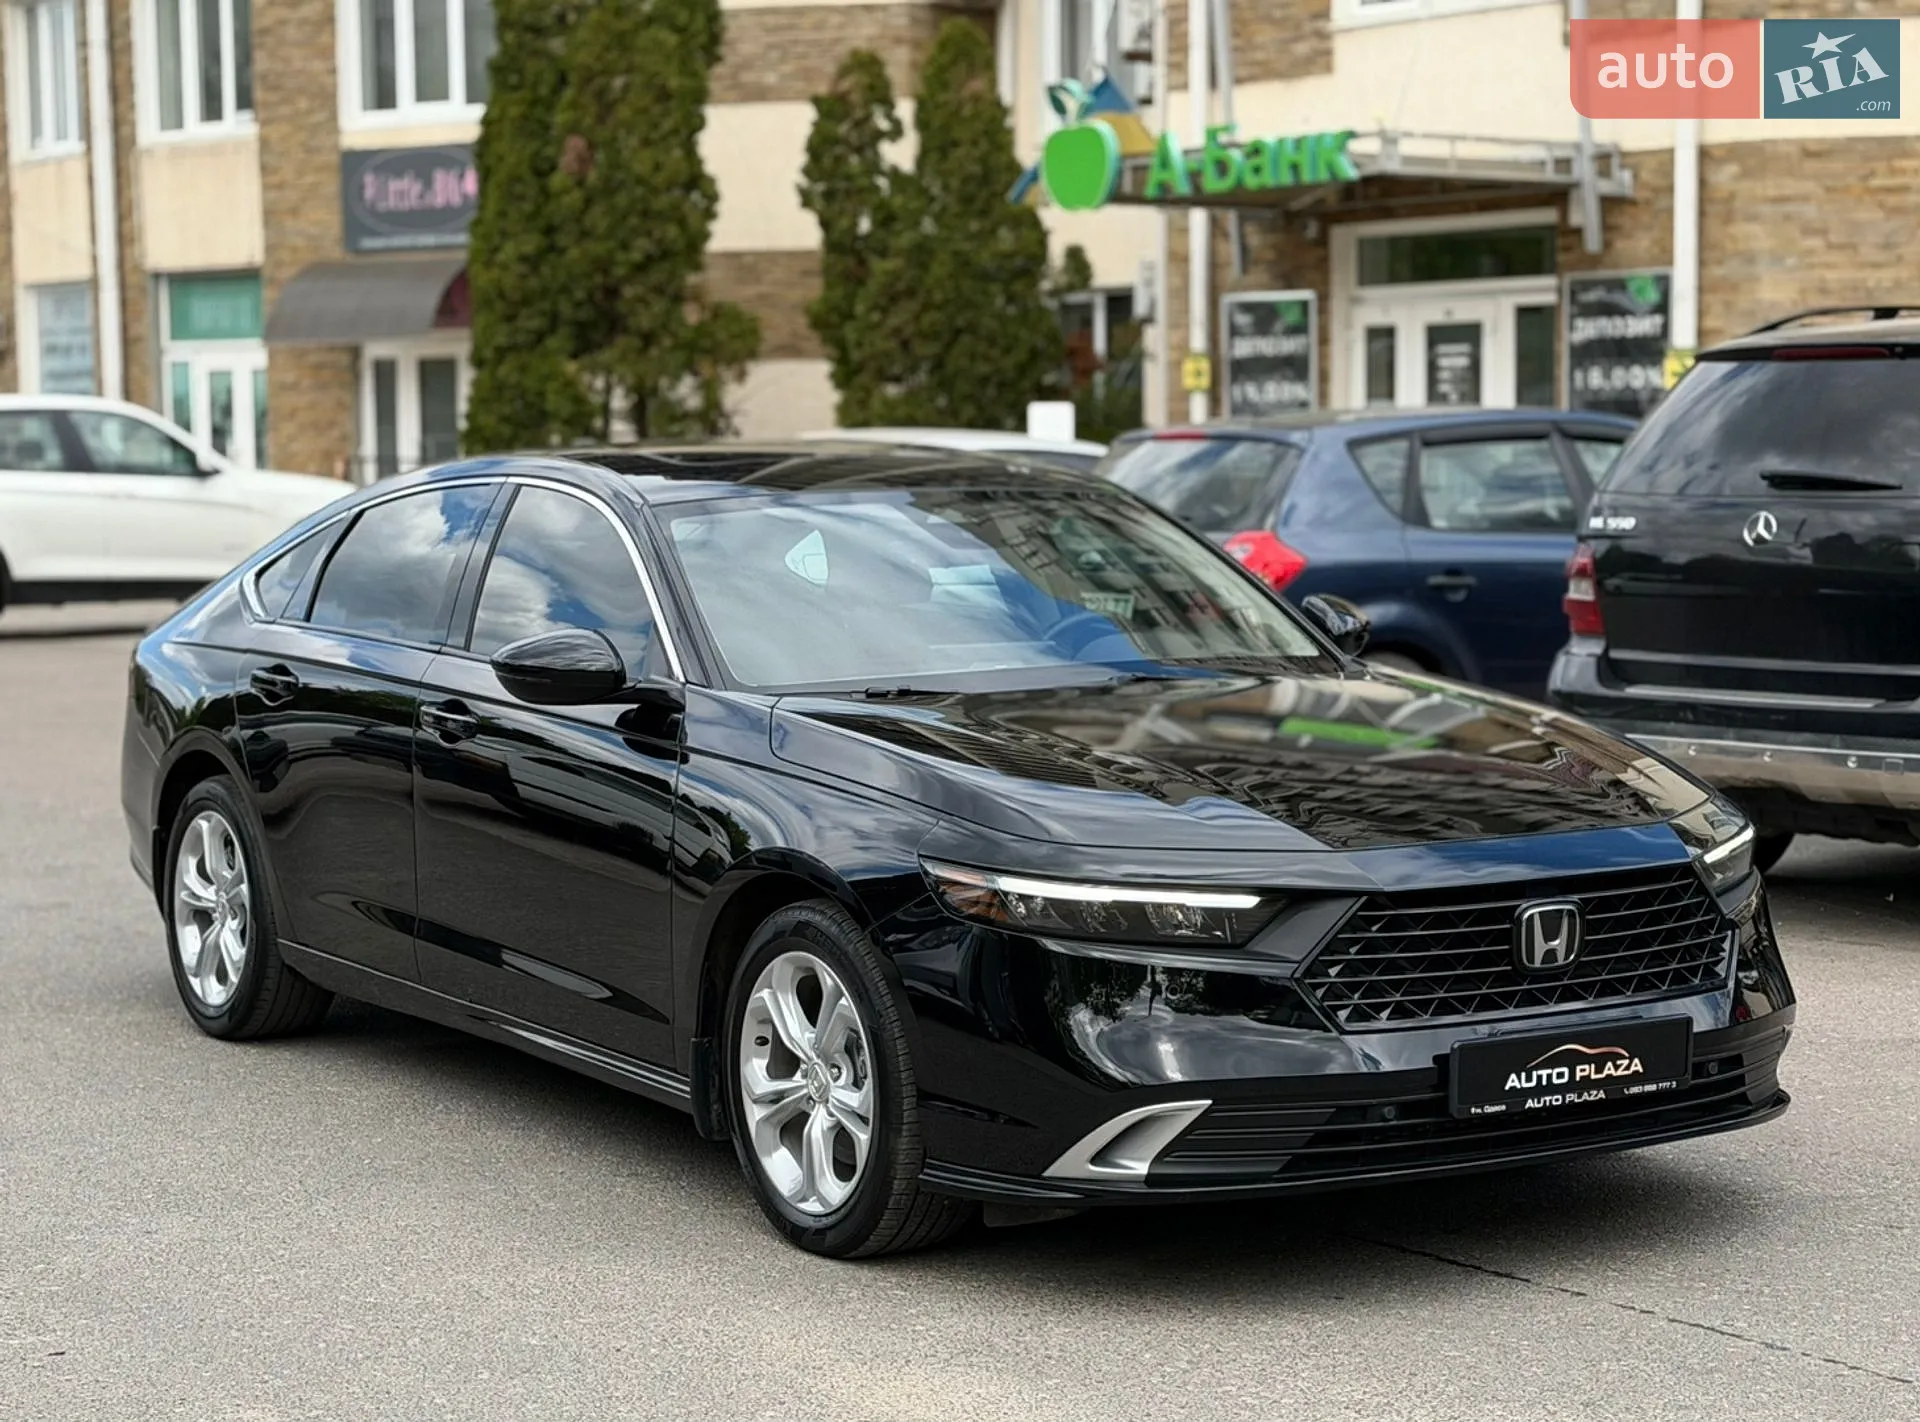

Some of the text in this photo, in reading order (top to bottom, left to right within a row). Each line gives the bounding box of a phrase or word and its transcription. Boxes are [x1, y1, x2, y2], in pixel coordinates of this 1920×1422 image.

[1145, 122, 1360, 199] А-Банк
[1504, 1057, 1644, 1091] AUTO PLAZA
[1524, 1089, 1606, 1110] AUTO PLAZA
